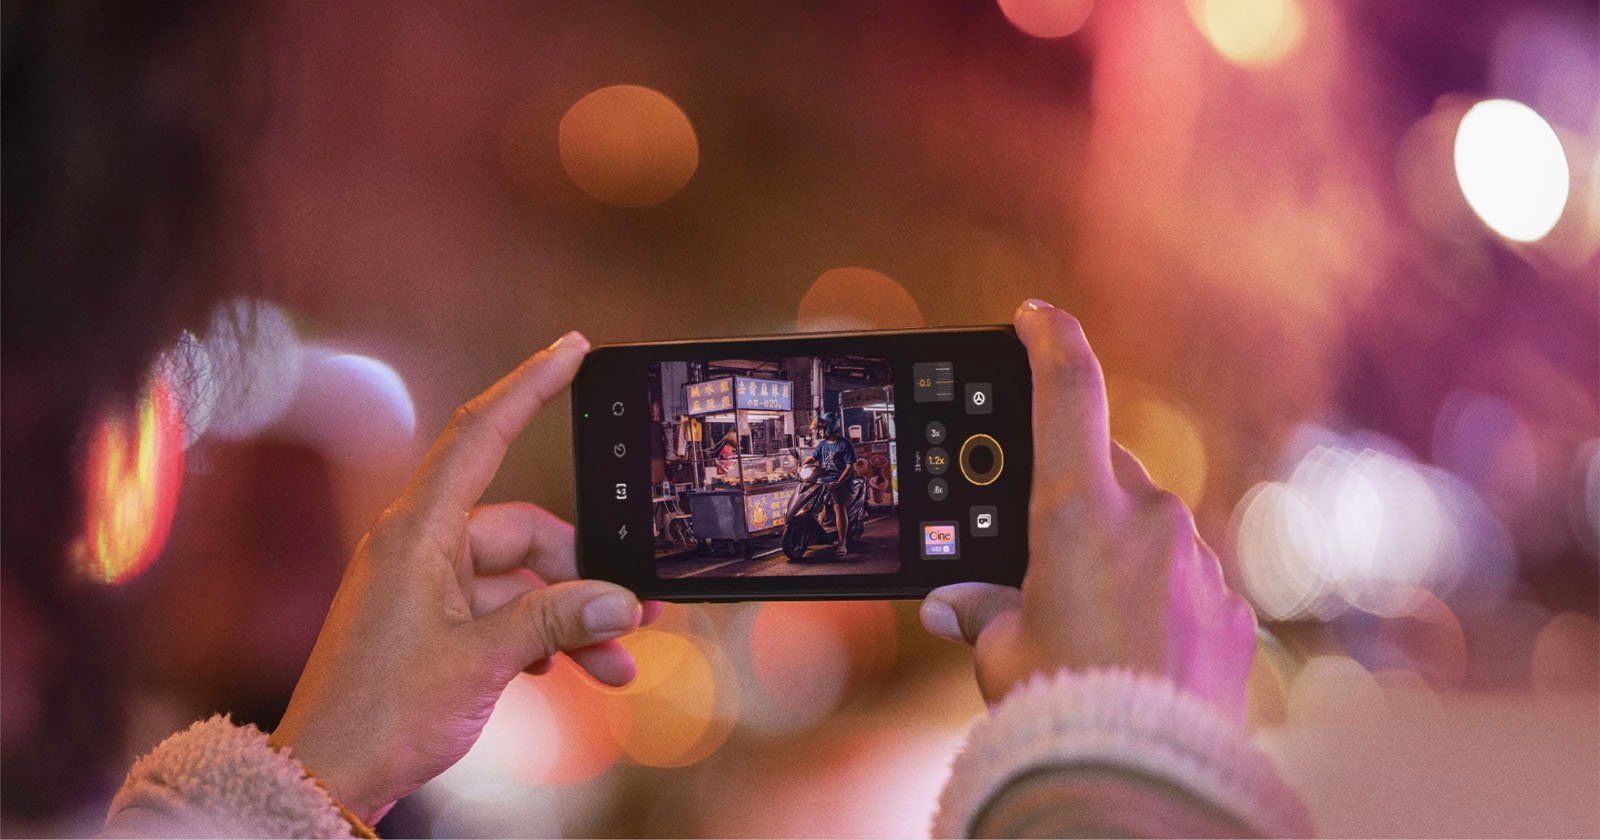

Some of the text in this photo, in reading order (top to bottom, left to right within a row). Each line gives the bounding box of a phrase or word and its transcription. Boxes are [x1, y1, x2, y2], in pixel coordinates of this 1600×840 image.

[916, 378, 932, 388] -0.5
[931, 429, 940, 438] 3x
[928, 456, 945, 465] 1.2x
[929, 530, 951, 541] Cine
